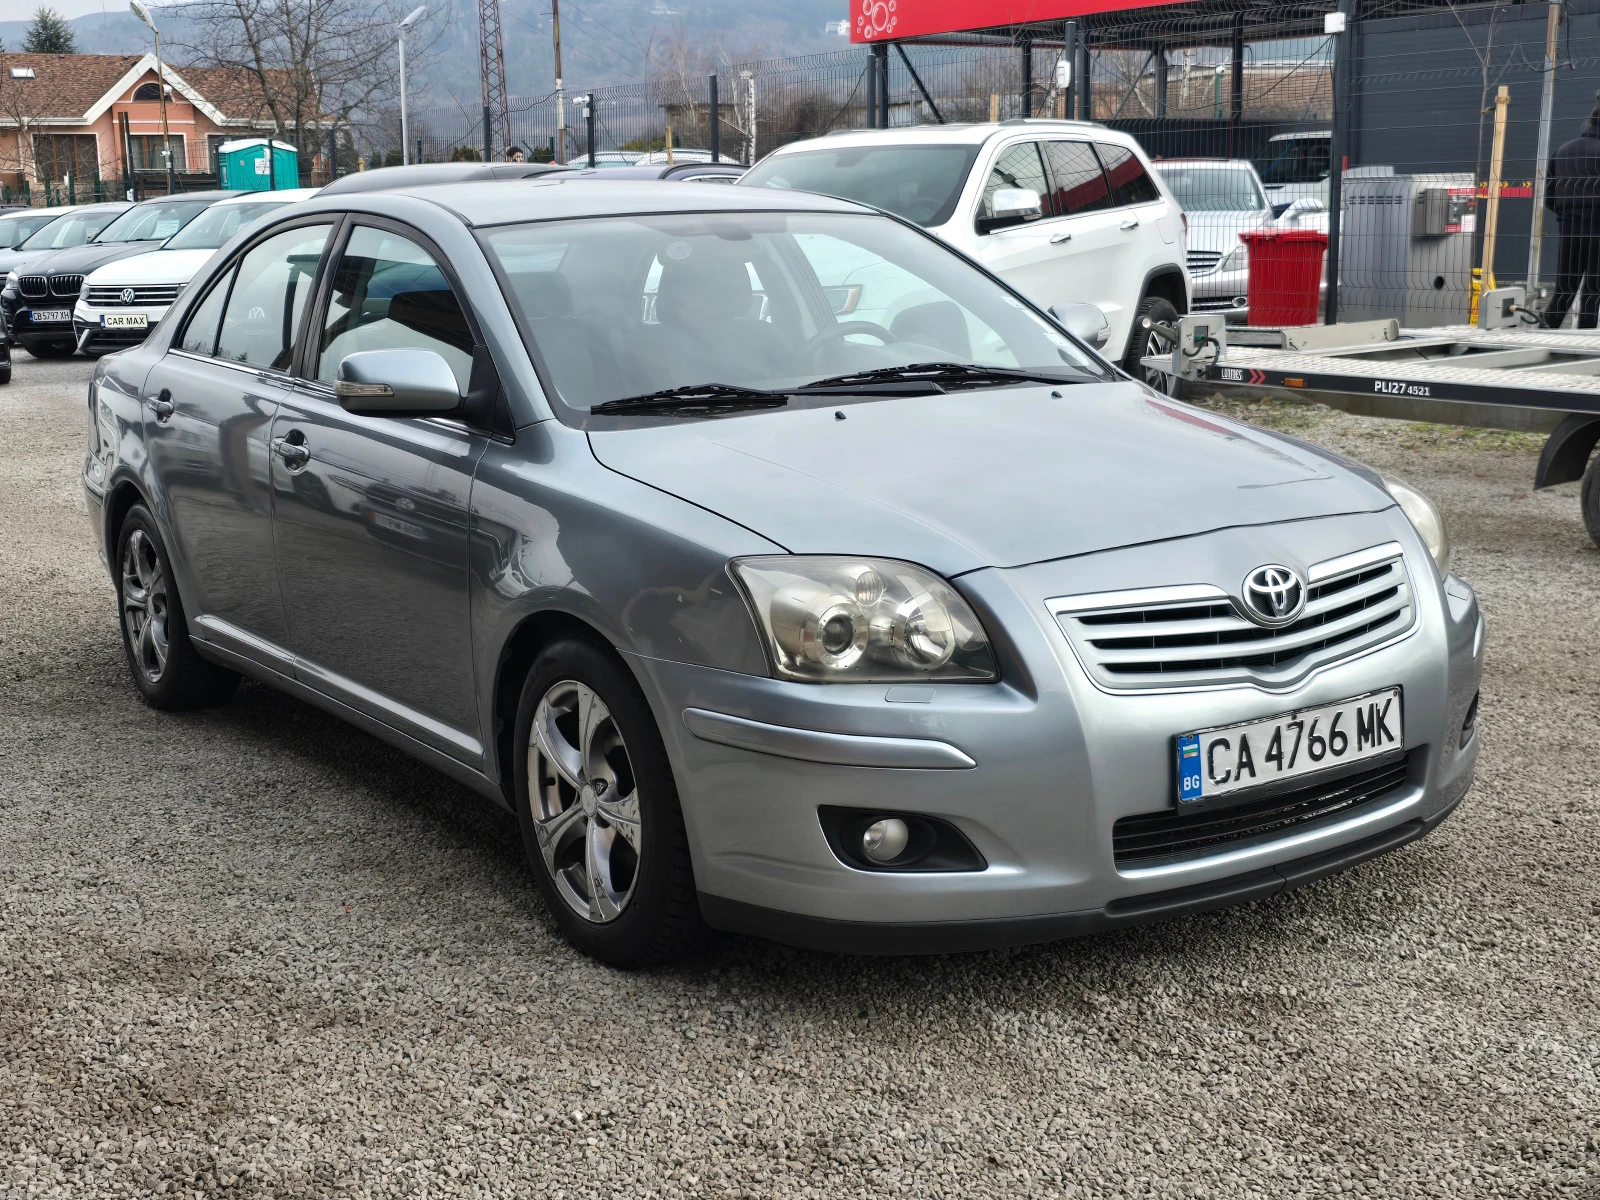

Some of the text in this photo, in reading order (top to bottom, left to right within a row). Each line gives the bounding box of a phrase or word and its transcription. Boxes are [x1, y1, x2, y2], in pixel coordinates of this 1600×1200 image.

[43, 311, 59, 320] 5797
[106, 317, 145, 326] CAR MAX
[1374, 381, 1430, 396] PLI27 4521
[1207, 698, 1395, 785] CA 4766 MK
[1183, 775, 1200, 791] BG
